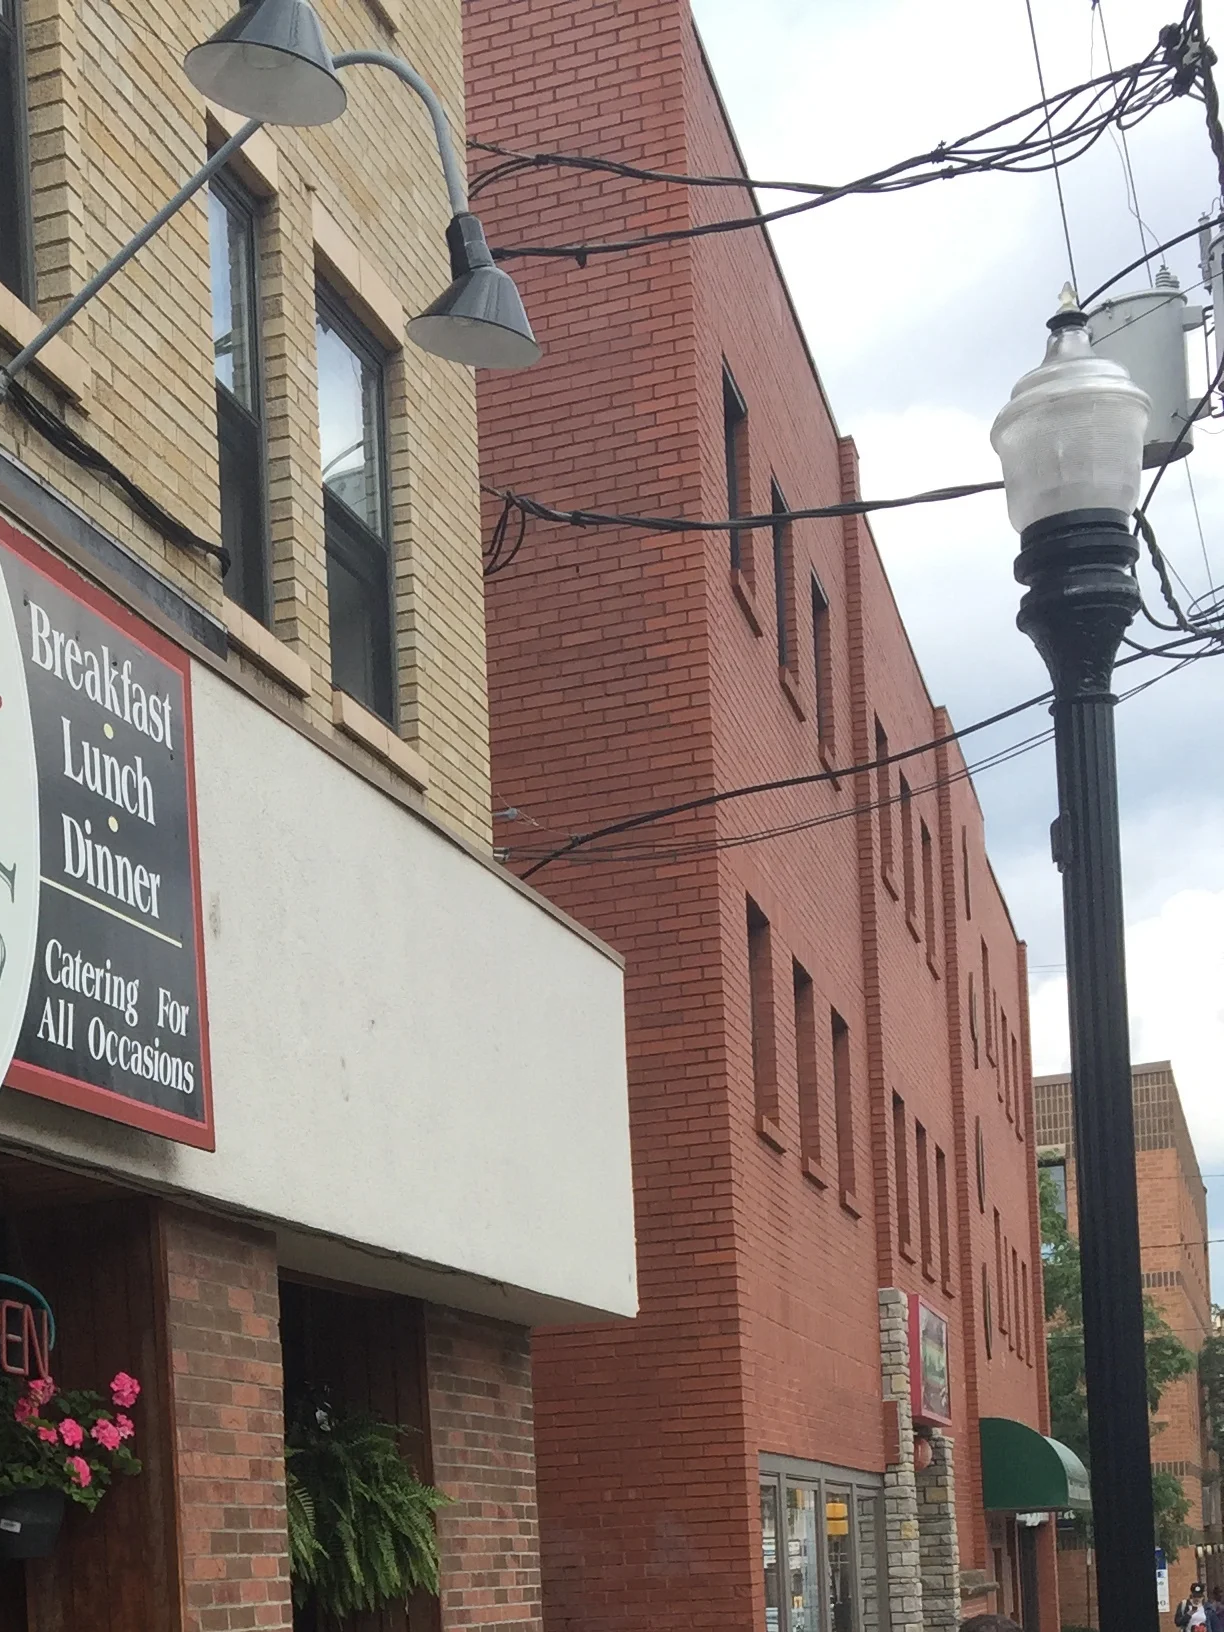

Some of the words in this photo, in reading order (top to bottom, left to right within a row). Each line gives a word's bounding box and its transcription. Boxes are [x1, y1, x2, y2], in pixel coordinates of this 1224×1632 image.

[29, 601, 174, 749] Breakfast
[61, 716, 156, 826] Lunch
[61, 813, 161, 919] Dinner
[45, 938, 139, 1026] Catering
[158, 987, 189, 1037] For
[37, 996, 74, 1051] All
[87, 1017, 194, 1094] Occasions
